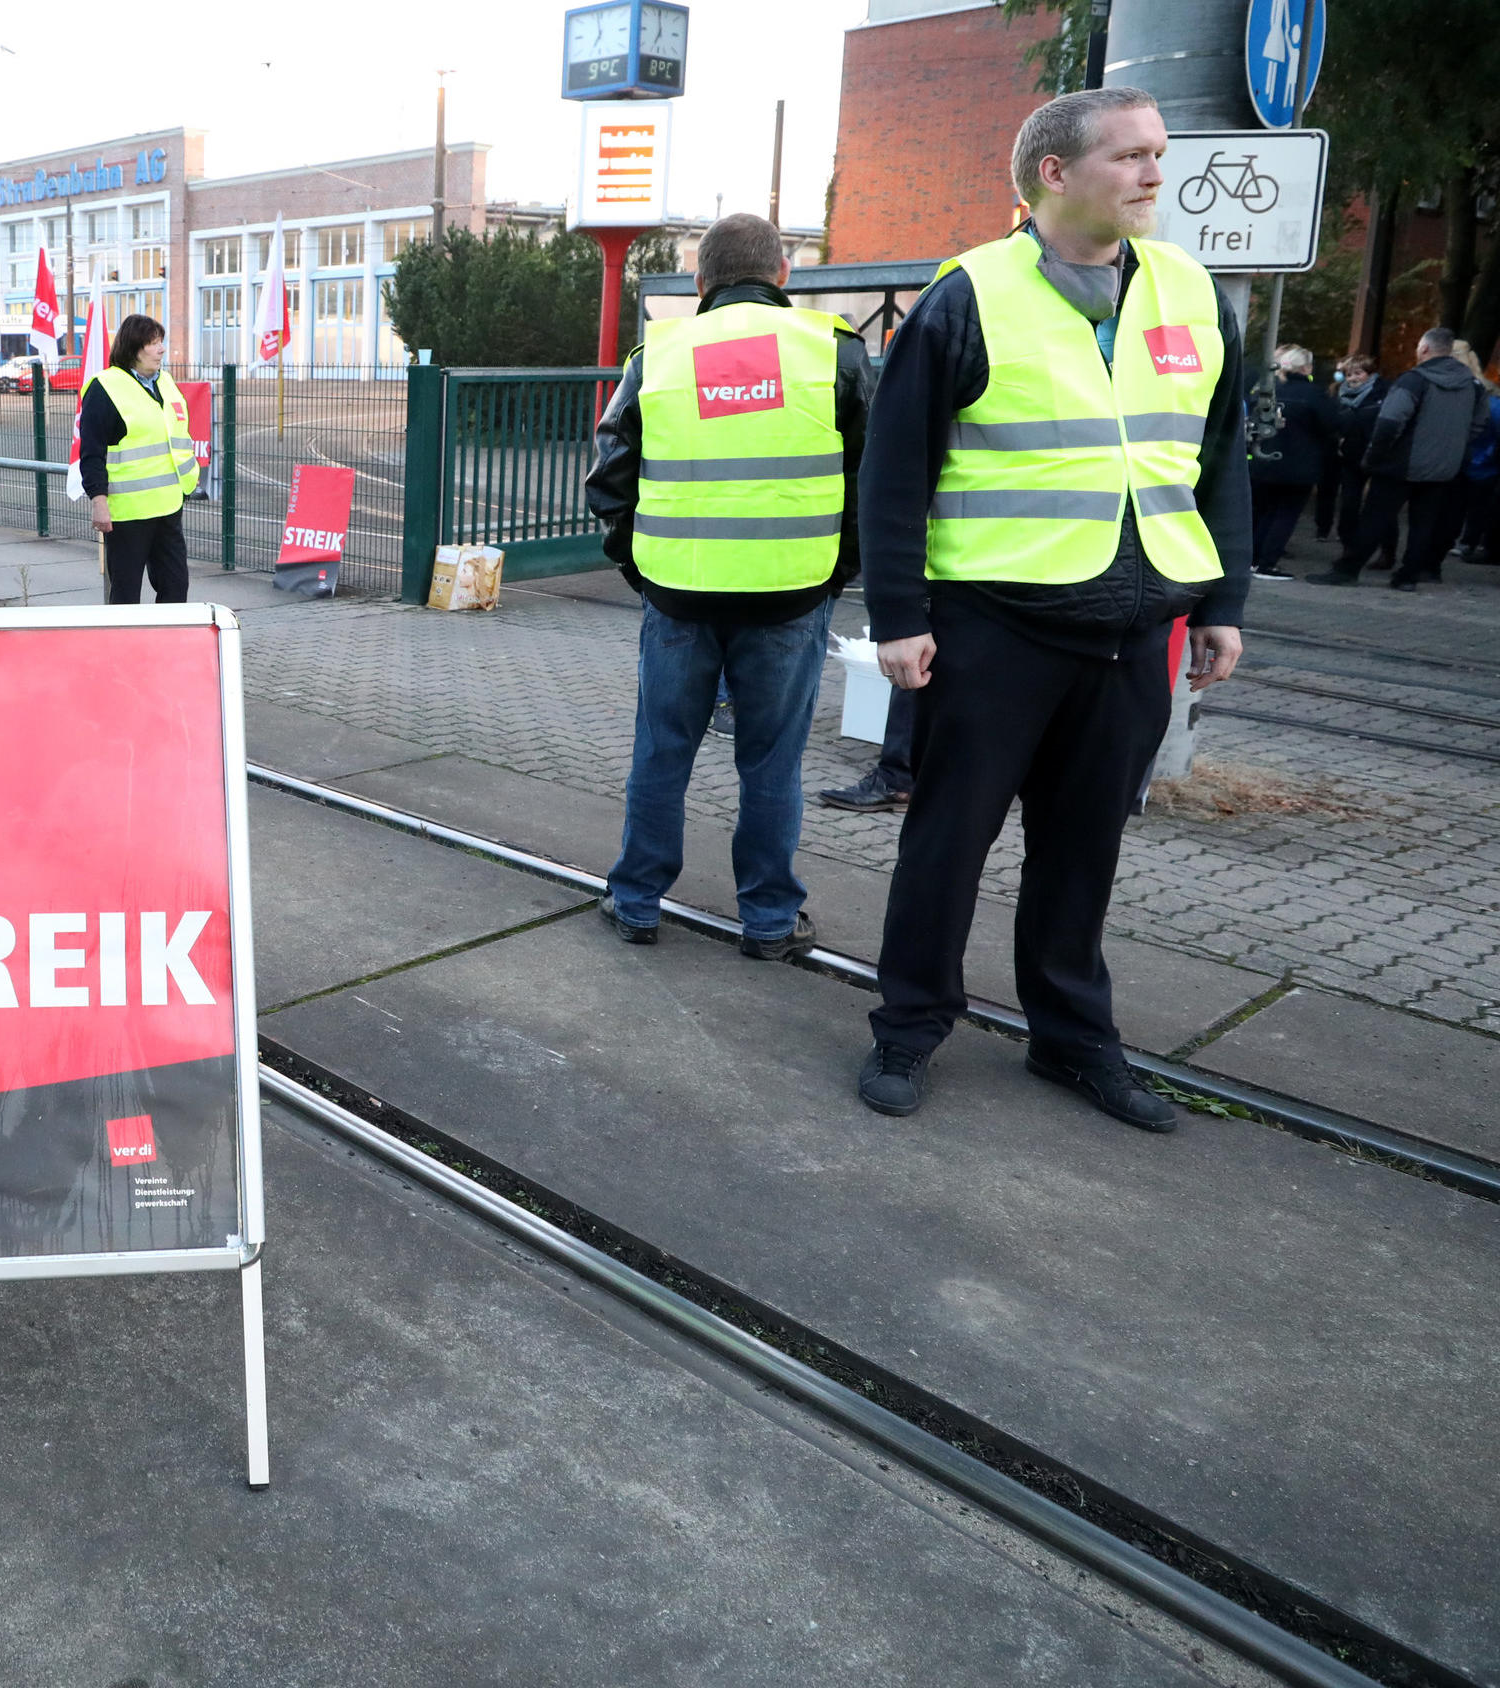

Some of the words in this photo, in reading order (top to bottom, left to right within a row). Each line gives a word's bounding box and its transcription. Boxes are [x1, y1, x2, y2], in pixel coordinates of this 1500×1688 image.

[136, 147, 167, 186] AG
[1198, 224, 1253, 251] frei
[1156, 354, 1198, 366] ver.di
[701, 379, 776, 401] ver.di
[284, 526, 345, 552] STREIK
[135, 1177, 168, 1185] Vereinte
[135, 1188, 195, 1197] Dienstleistungs
[135, 1199, 188, 1209] gewerkschaft
